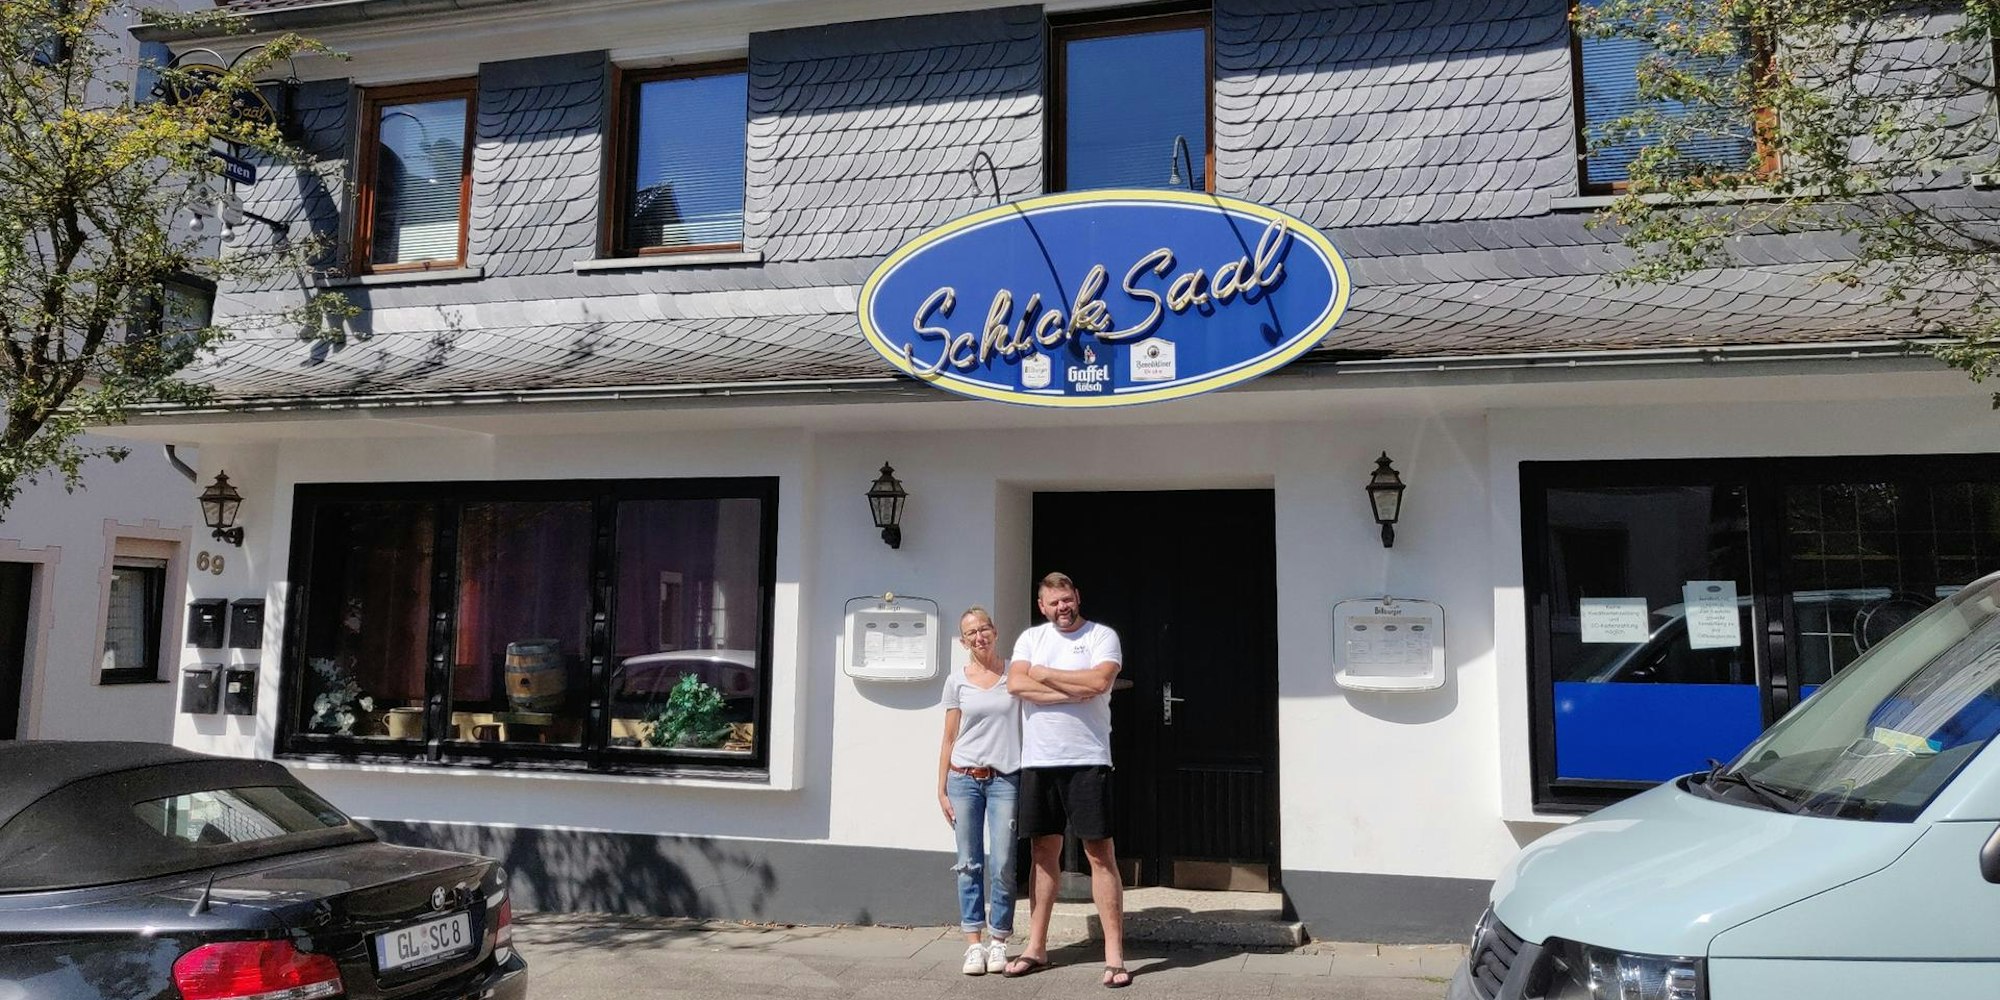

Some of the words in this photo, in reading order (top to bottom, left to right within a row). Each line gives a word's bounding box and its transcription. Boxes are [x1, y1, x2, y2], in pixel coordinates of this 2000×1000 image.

[903, 263, 1111, 376] Schick
[1095, 216, 1288, 339] Saal
[1067, 365, 1110, 382] Gaffel
[1075, 381, 1102, 392] Kölsch
[196, 550, 225, 576] 69
[397, 930, 420, 960] GL
[429, 922, 450, 950] SC
[452, 919, 461, 944] 8
